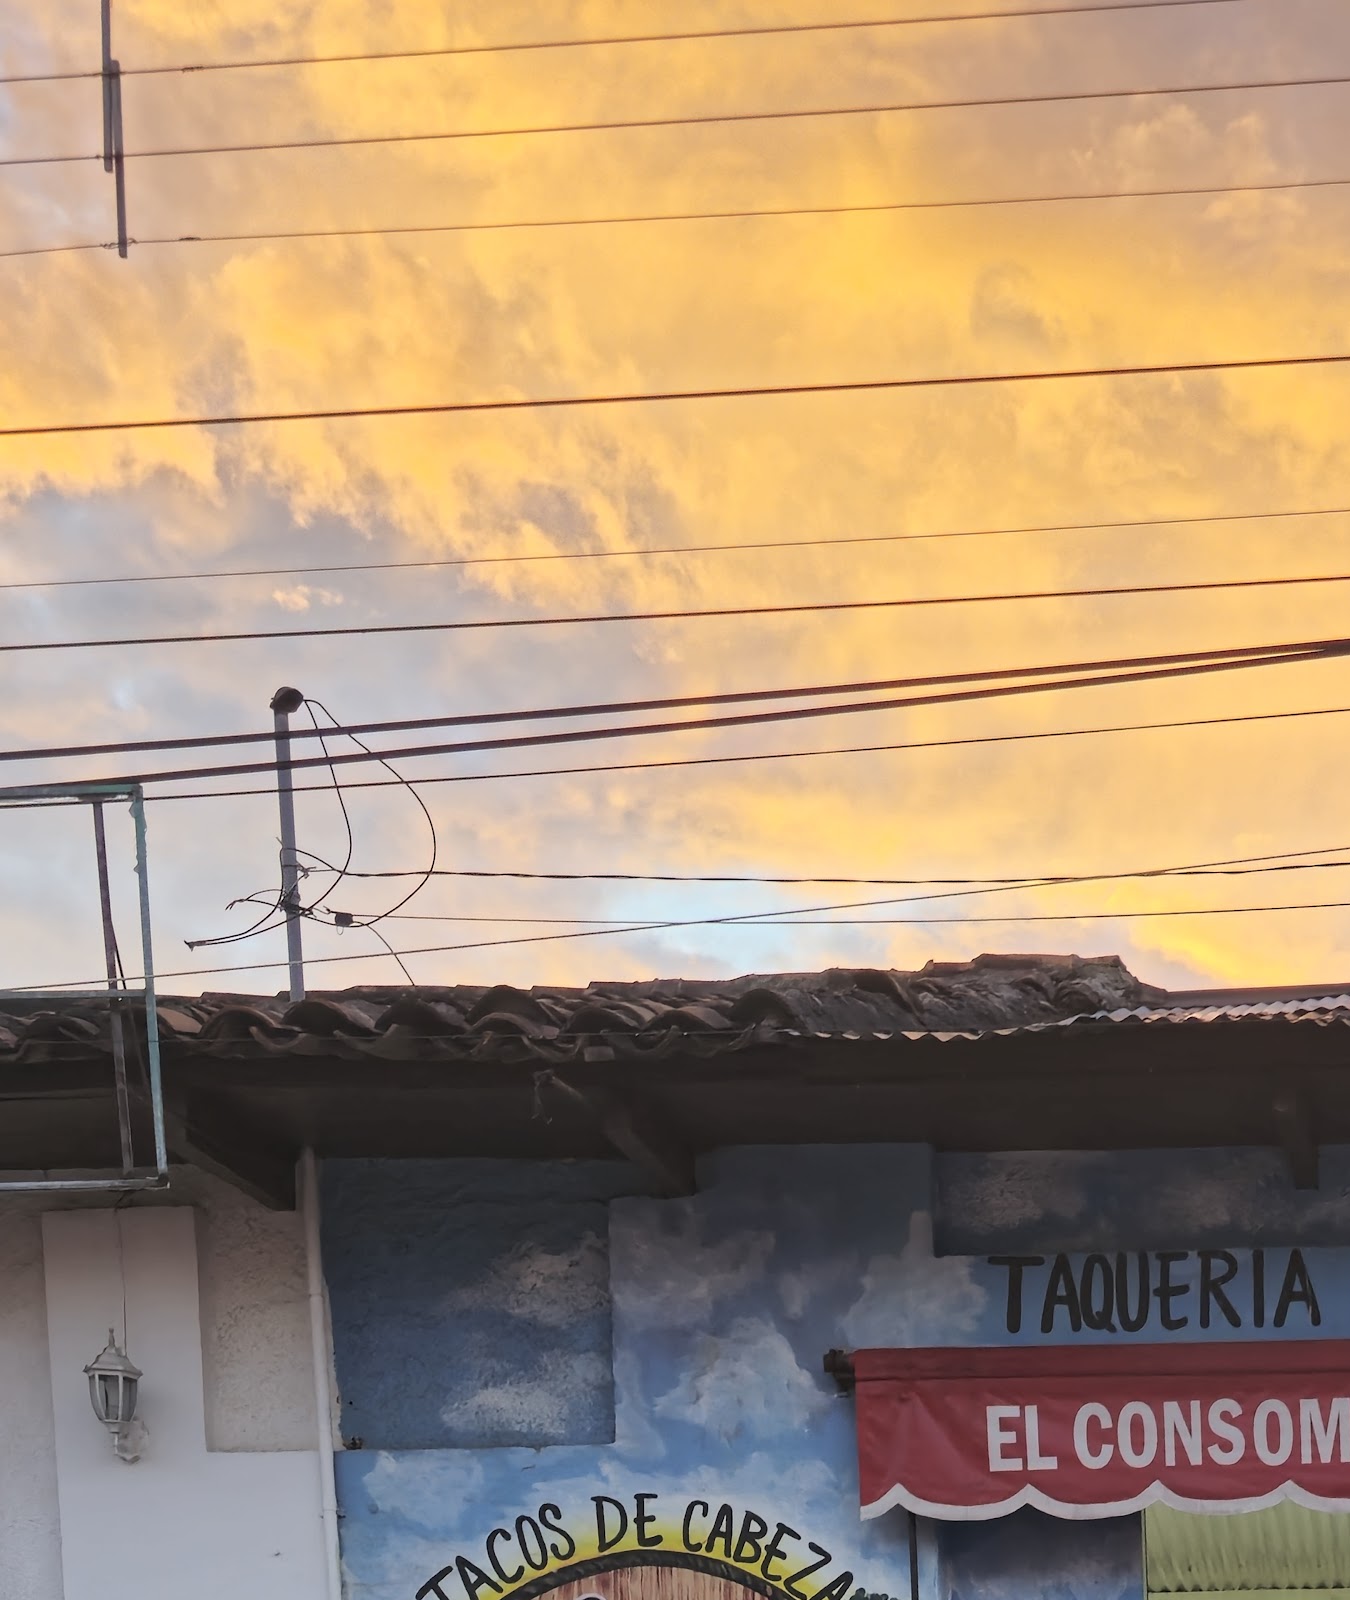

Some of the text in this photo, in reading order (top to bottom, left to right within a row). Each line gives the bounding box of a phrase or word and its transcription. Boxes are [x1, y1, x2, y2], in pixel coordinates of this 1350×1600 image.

[987, 1247, 1322, 1334] TAQUERIA
[985, 1404, 1058, 1472] EL
[590, 1493, 664, 1553] DE
